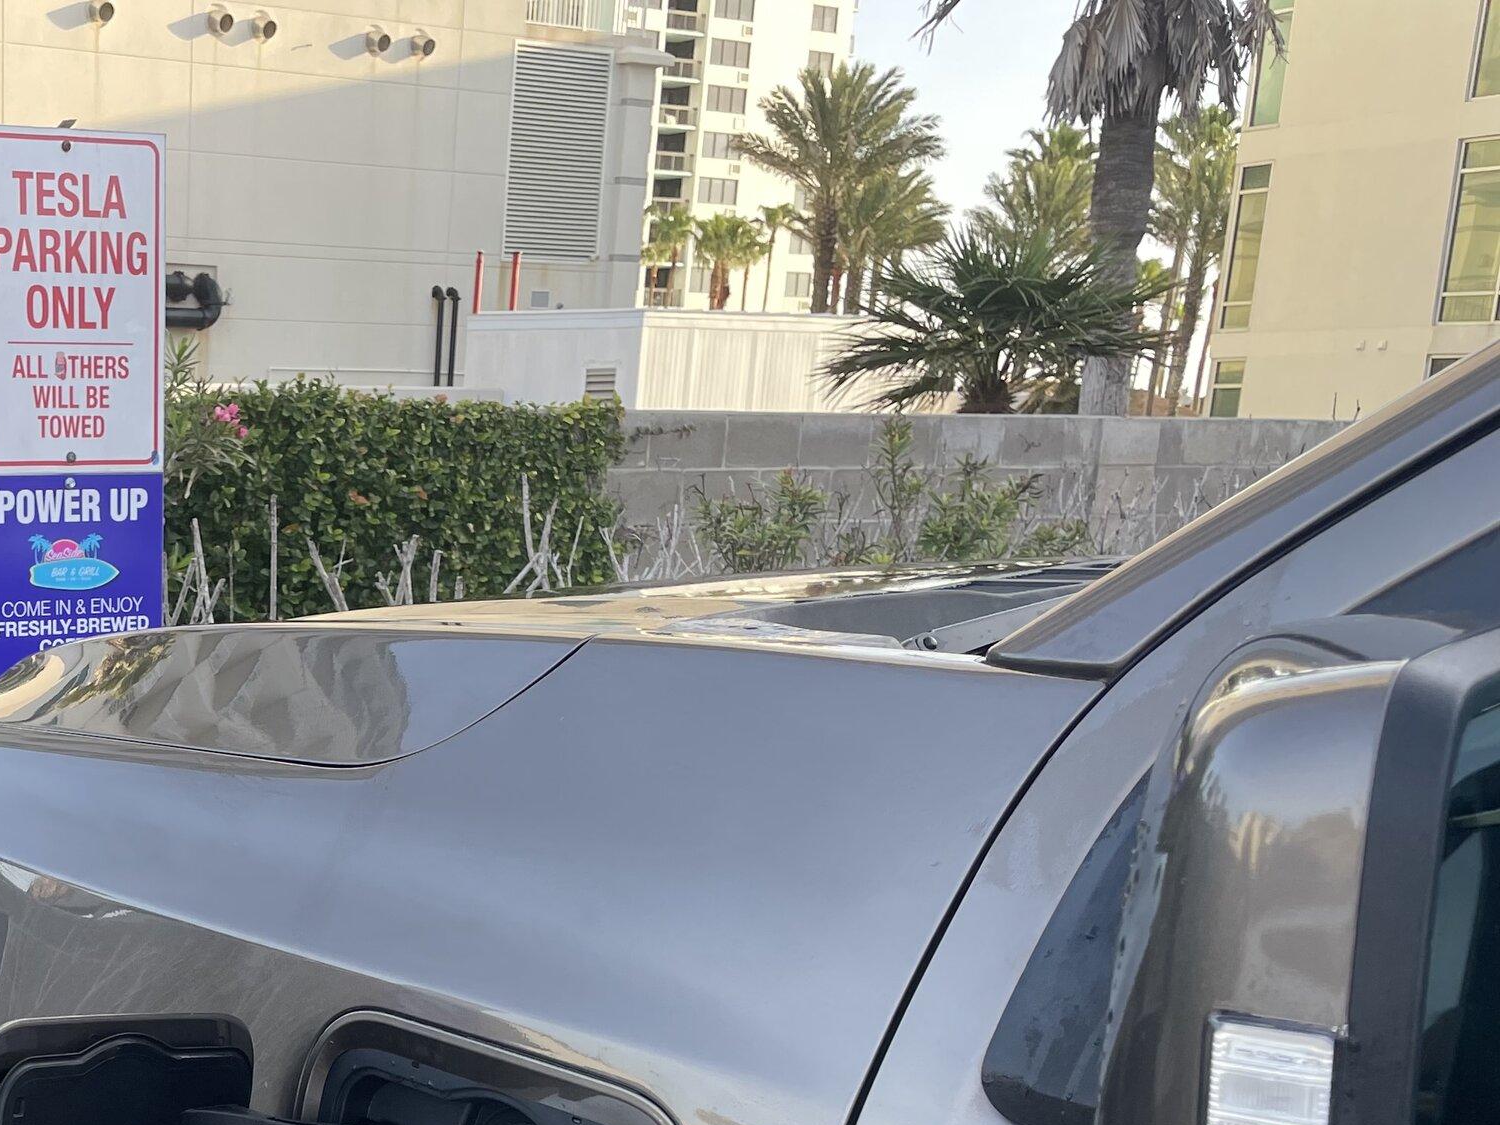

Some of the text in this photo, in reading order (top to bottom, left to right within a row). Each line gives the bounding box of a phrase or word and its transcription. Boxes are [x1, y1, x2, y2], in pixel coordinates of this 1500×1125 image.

[12, 170, 127, 219] TESLA
[26, 284, 116, 330] ONLY
[12, 355, 48, 378] ALL
[32, 385, 110, 409] WILL BE
[37, 415, 105, 438] TOWED
[110, 487, 148, 522] UP
[78, 566, 100, 577] GRILL
[1, 596, 144, 618] COME IN & ENJOY
